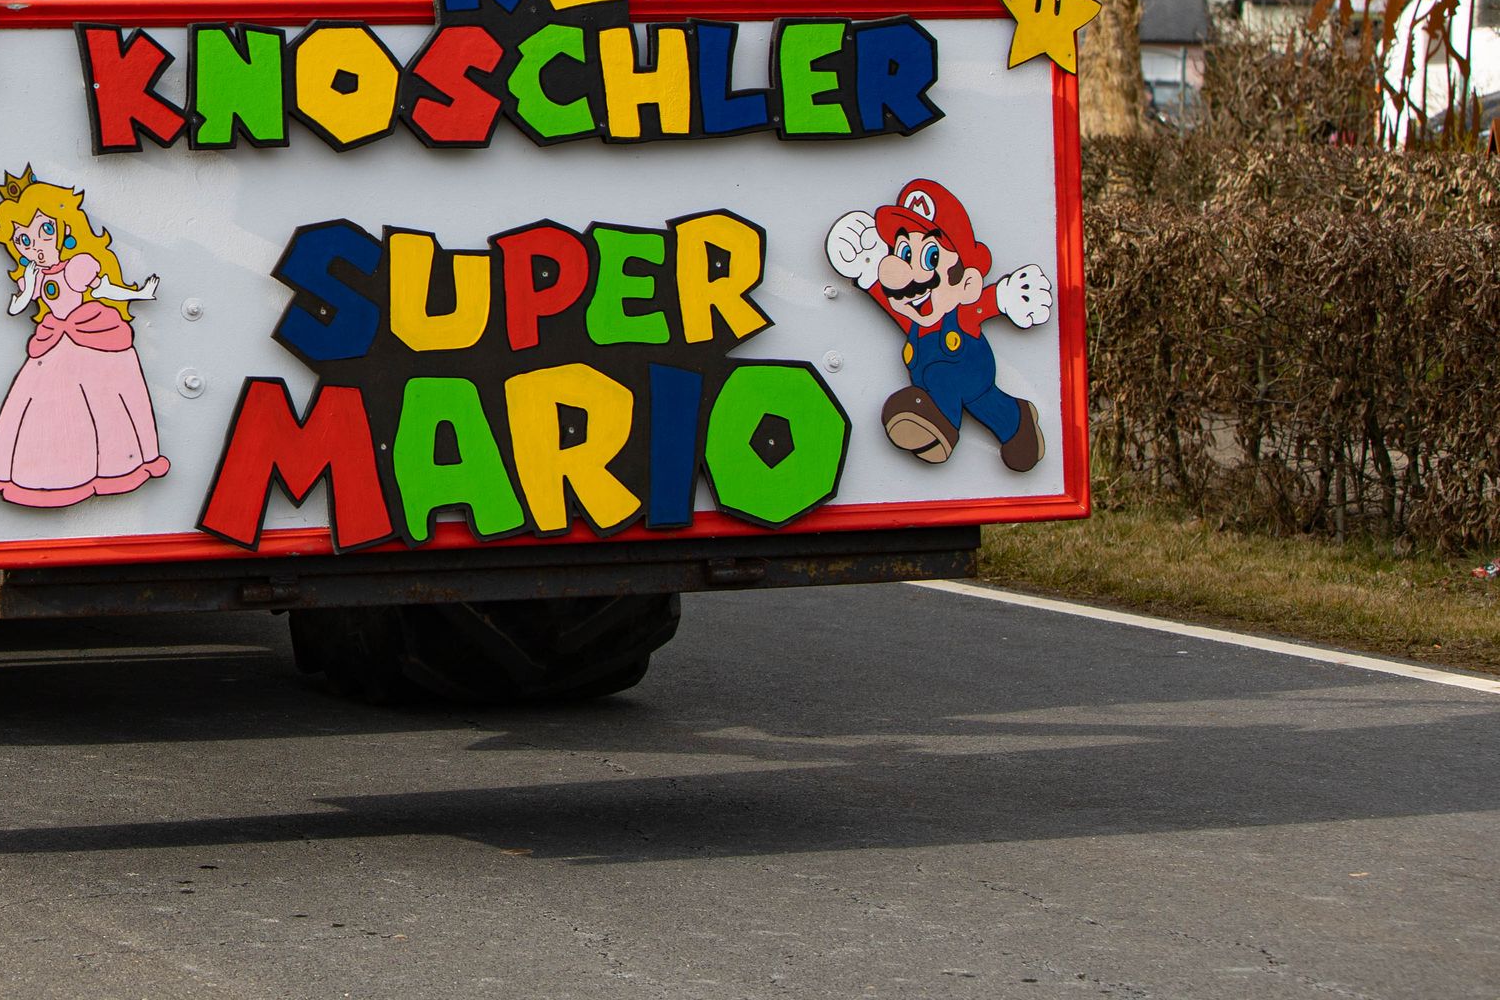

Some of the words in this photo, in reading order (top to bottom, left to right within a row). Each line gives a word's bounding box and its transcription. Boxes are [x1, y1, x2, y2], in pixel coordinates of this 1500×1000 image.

[76, 15, 944, 154] KNOSCHLER
[908, 195, 931, 216] M
[273, 210, 772, 364] SUPER
[197, 360, 850, 552] MARIO
